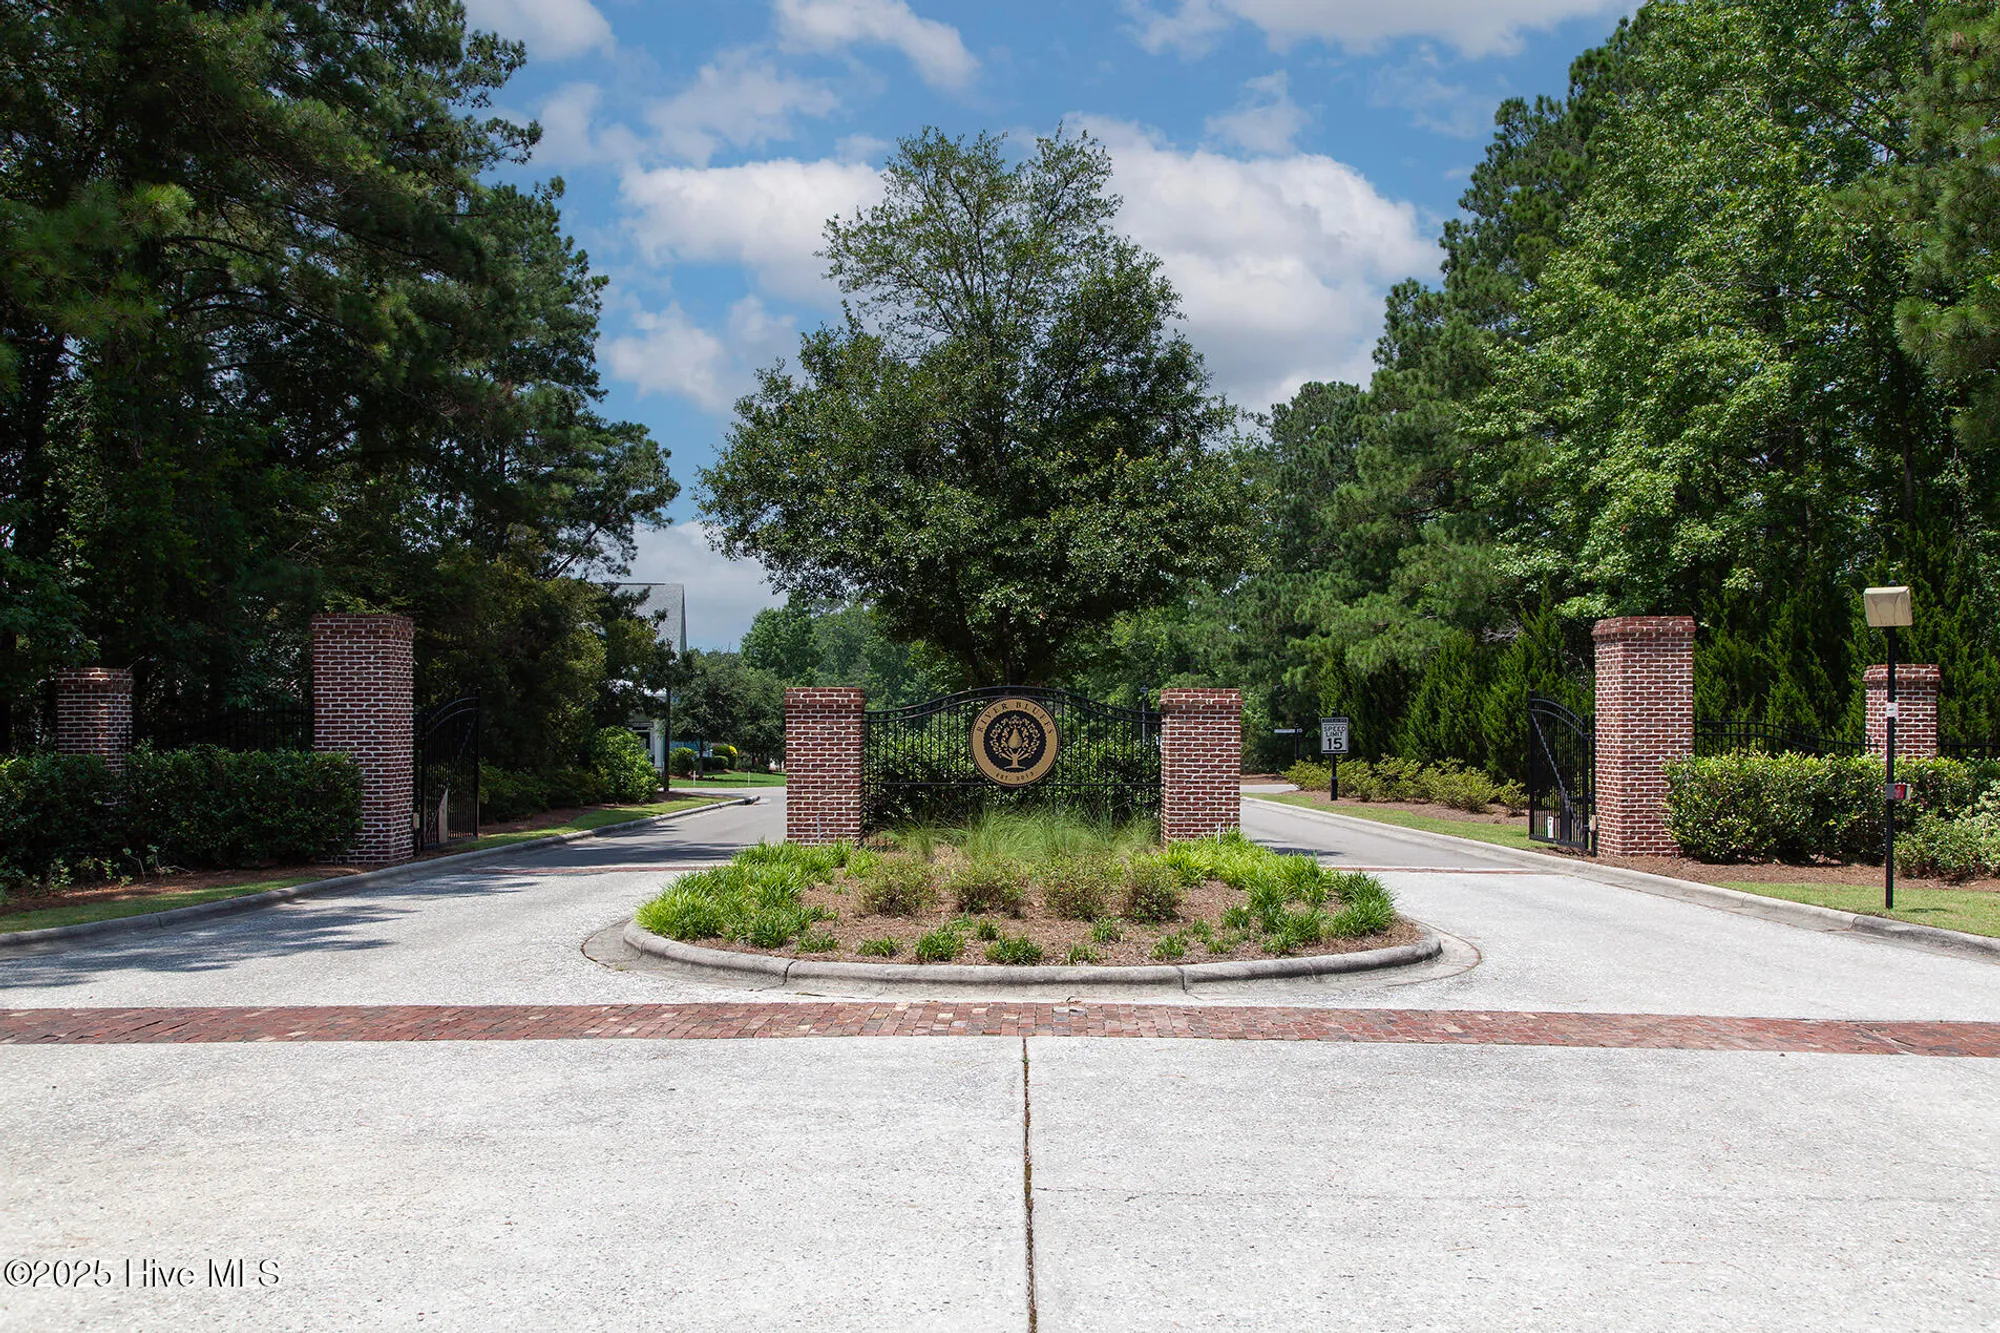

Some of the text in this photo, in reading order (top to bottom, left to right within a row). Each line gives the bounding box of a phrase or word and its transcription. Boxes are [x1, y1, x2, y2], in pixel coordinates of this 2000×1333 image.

[977, 701, 1055, 735] RIVER BLUFFS
[1327, 737, 1343, 750] 15
